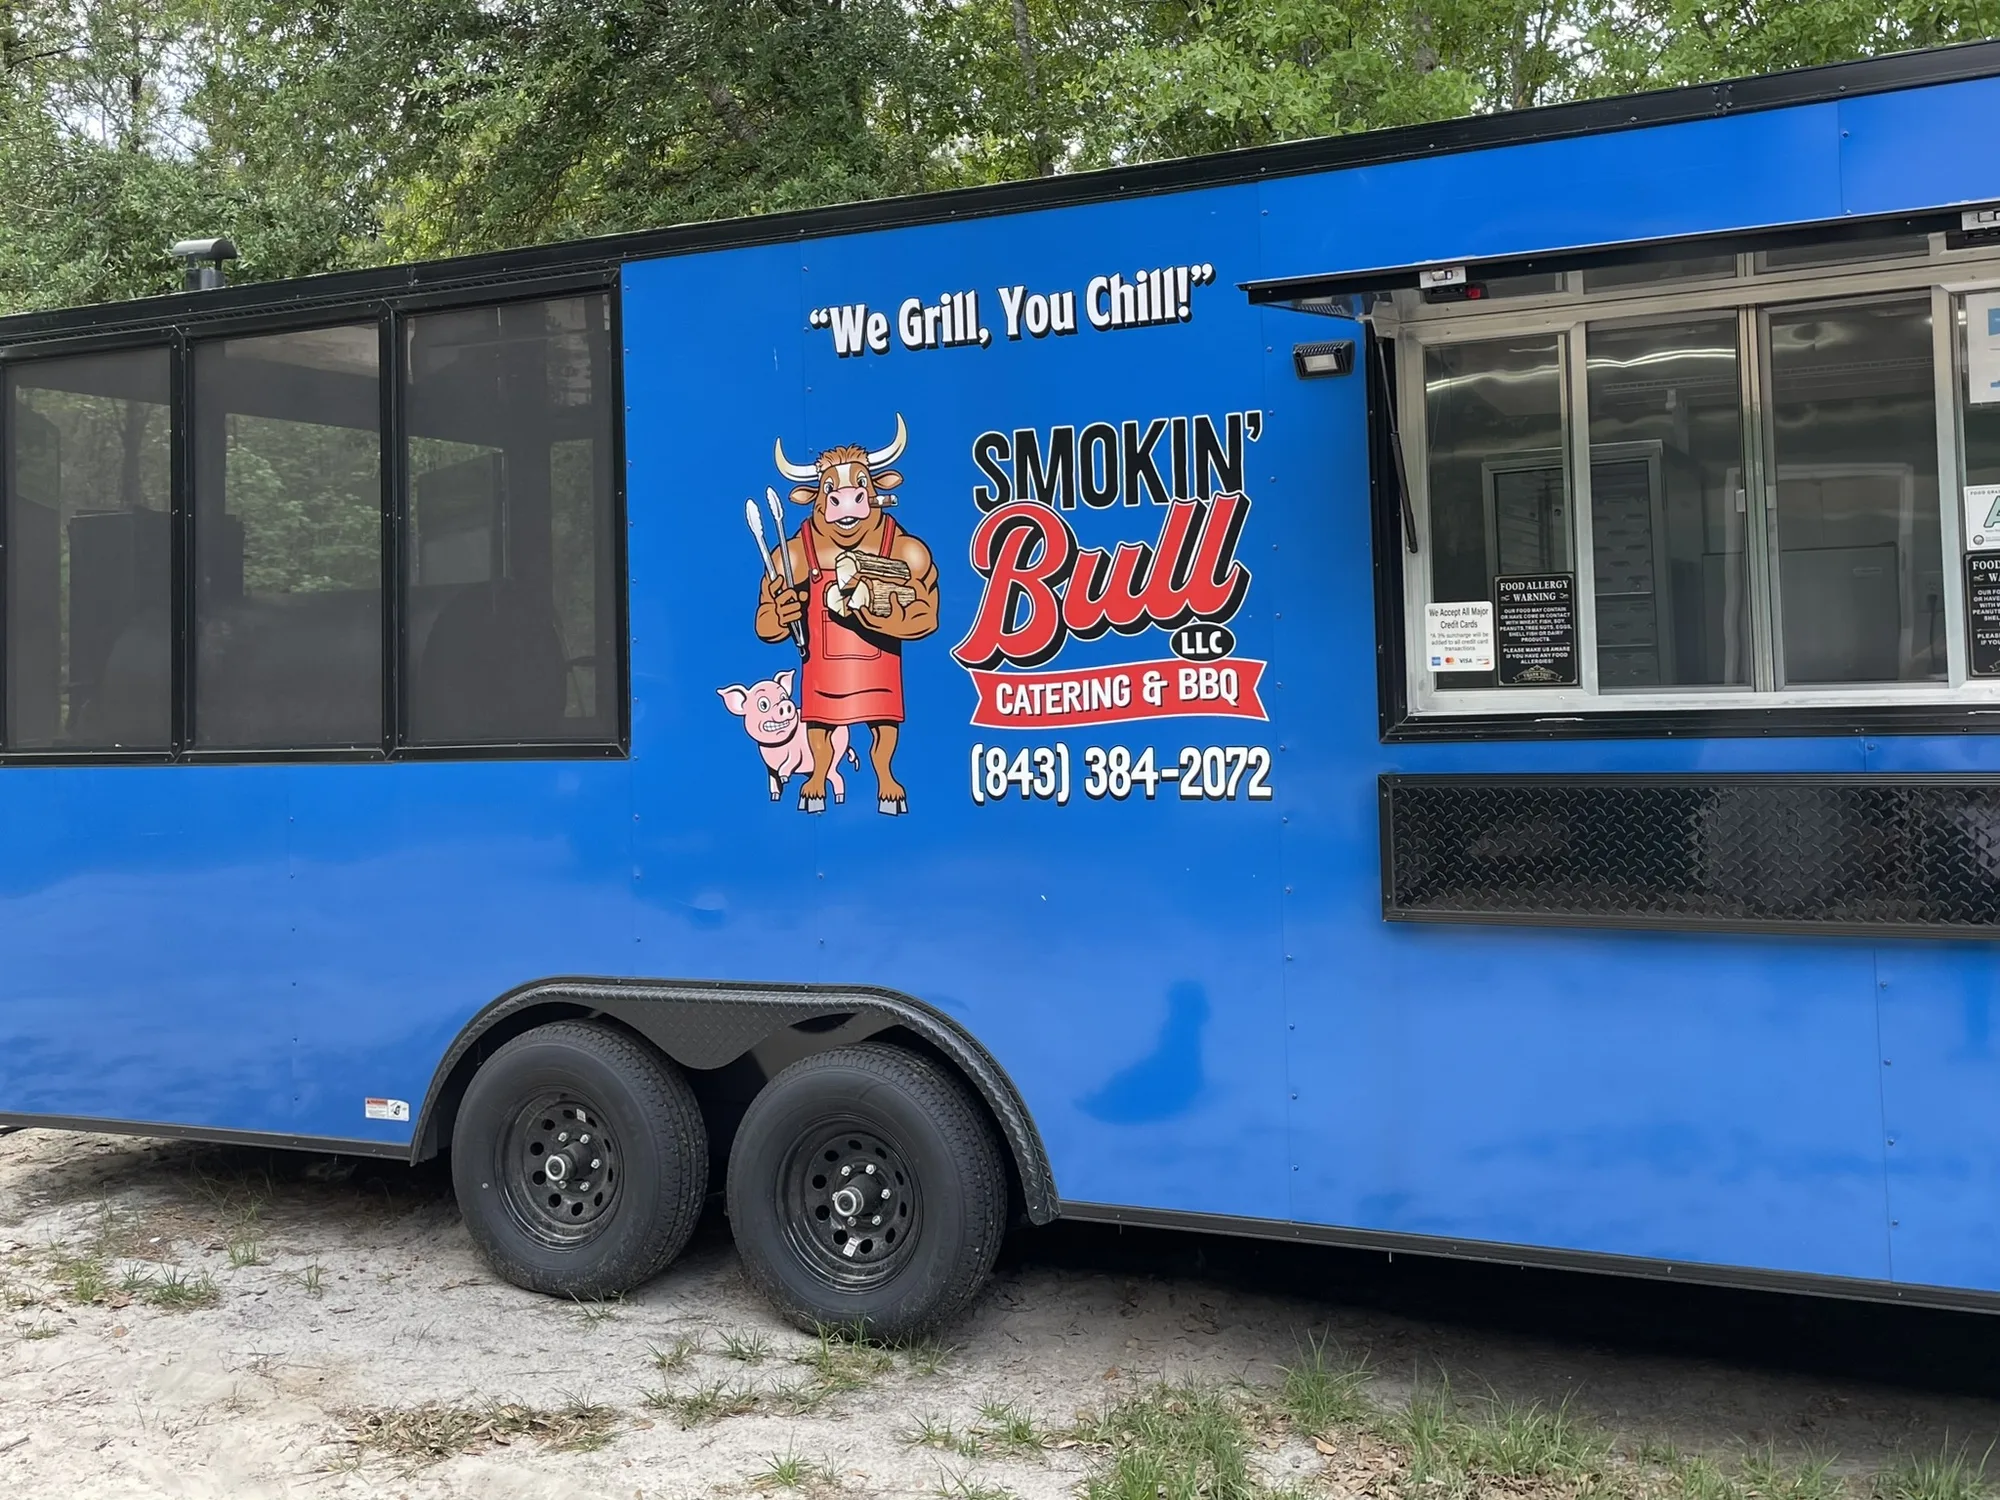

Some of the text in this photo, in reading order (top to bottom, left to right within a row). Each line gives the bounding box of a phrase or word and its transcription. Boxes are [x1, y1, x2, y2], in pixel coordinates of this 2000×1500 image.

[808, 262, 1216, 358] “We Grill, You Chill!”
[974, 410, 1262, 514] SMOKIN’
[1973, 560, 2000, 570] FOOD
[951, 490, 1251, 670] Bull
[1500, 580, 1568, 591] FOOD ALLERGY
[1513, 592, 1556, 602] WARNING
[1440, 608, 1460, 617] Accept
[1472, 607, 1488, 617] Major
[1440, 620, 1458, 629] Credit
[1181, 630, 1222, 655] LLC
[996, 667, 1240, 716] CATERING & BBQ
[971, 742, 1272, 806] (843) 384-2072
